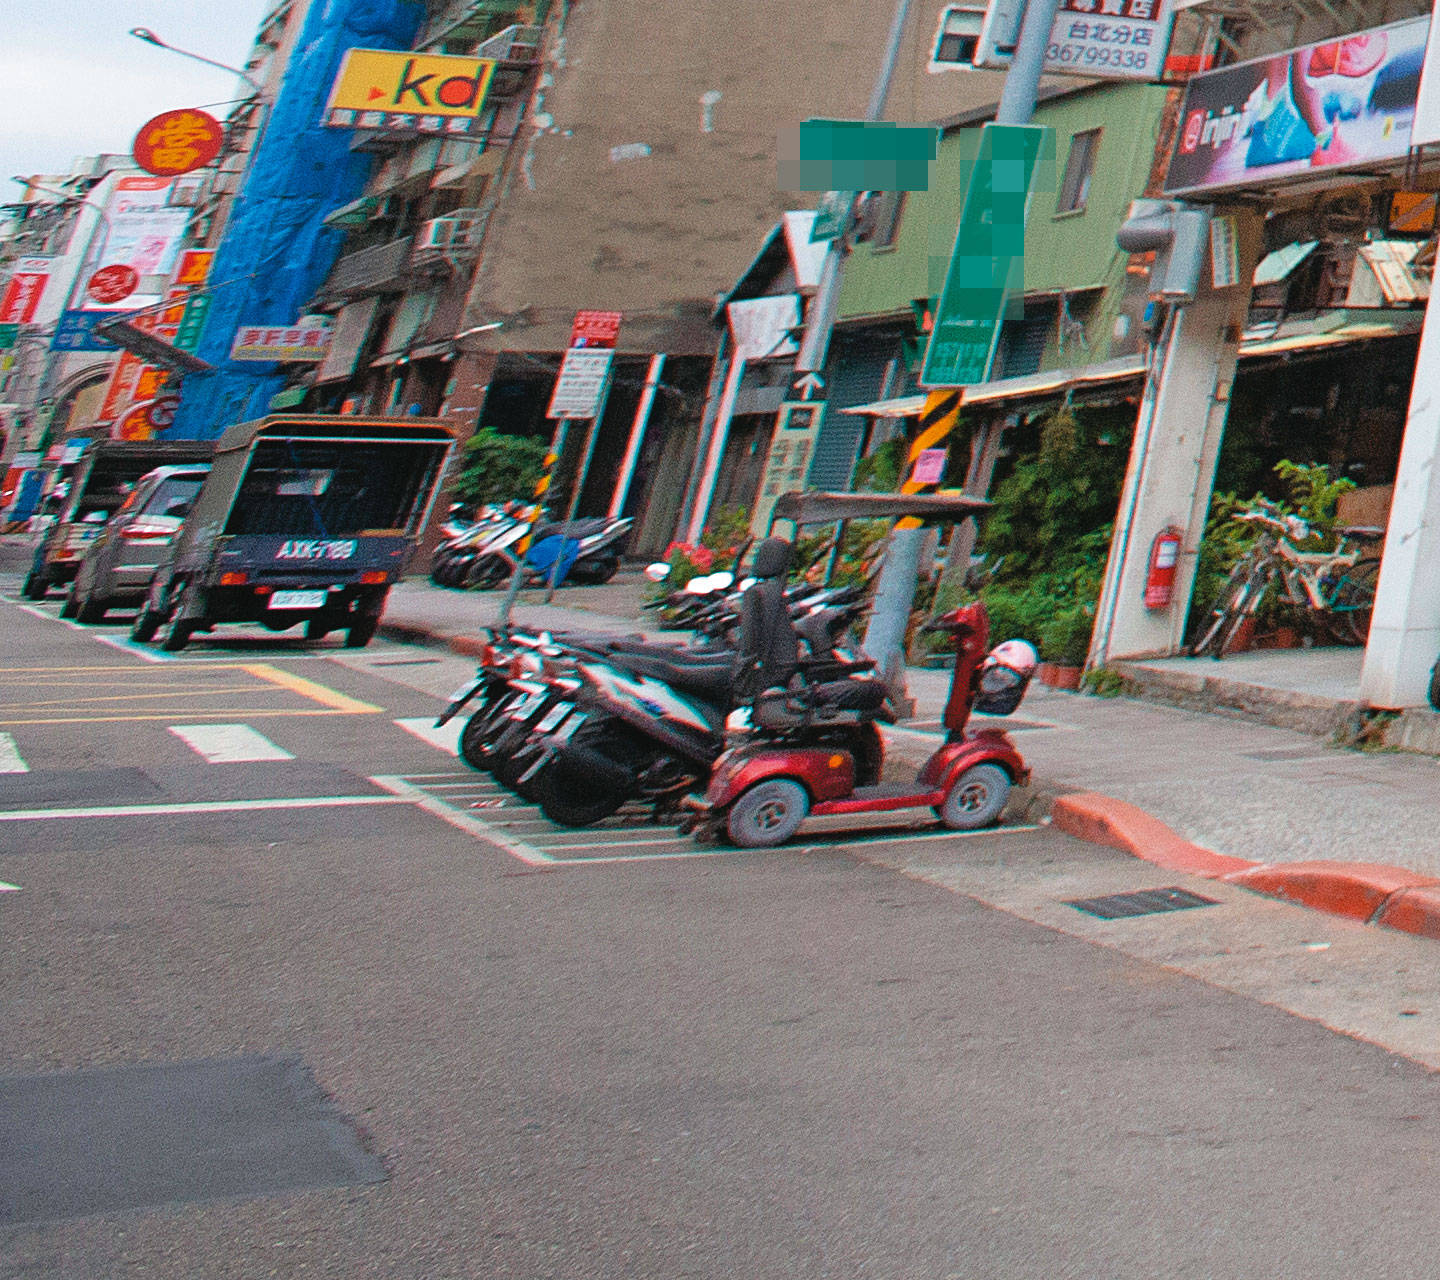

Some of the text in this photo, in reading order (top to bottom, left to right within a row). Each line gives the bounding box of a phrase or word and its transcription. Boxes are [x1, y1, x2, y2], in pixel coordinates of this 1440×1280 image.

[1068, 21, 1153, 47] 台北分店
[149, 112, 213, 170] 當
